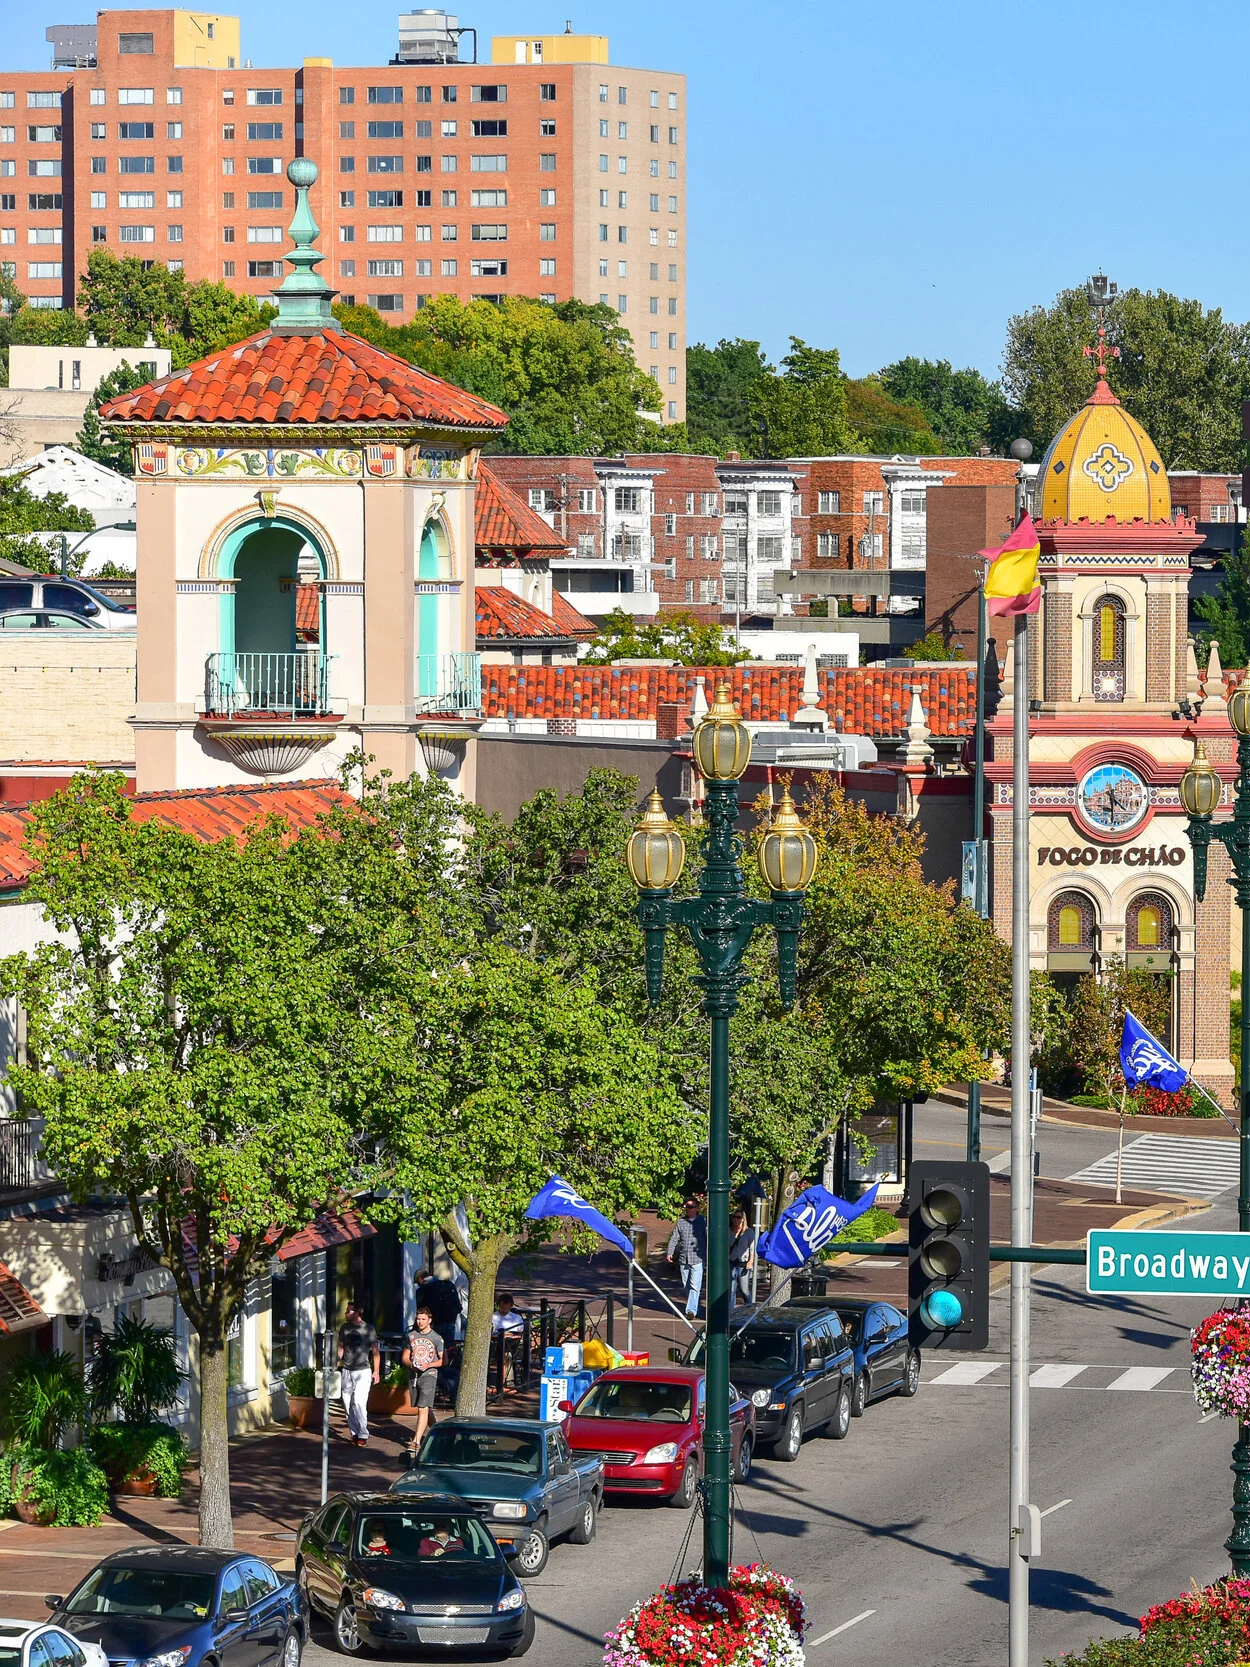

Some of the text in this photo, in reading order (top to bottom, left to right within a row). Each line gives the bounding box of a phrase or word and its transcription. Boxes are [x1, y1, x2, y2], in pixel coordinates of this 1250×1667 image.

[1037, 847, 1099, 866] FOGO
[1100, 849, 1122, 864] DE
[1098, 1245, 1250, 1288] Broadway
